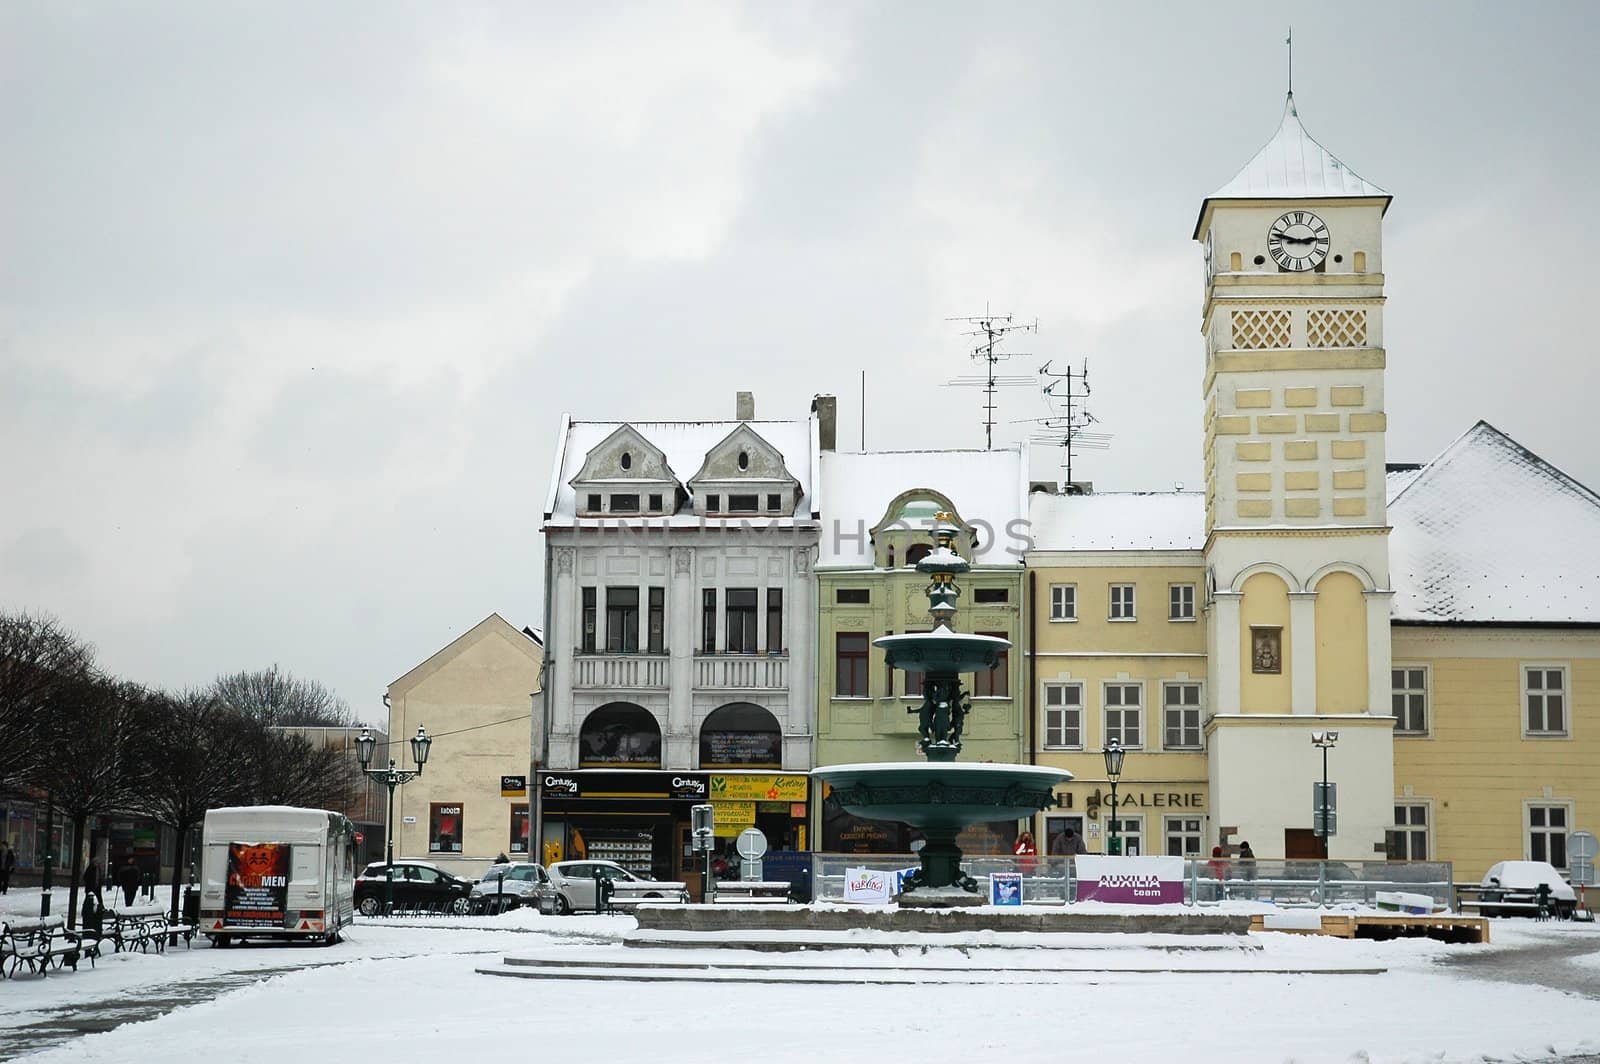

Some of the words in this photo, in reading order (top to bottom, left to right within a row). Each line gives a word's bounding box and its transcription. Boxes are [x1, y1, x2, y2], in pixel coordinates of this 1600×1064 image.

[545, 776, 572, 787] Century
[569, 782, 577, 792] 21
[672, 777, 700, 788] Century
[696, 783, 705, 793] 21
[1103, 793, 1204, 807] GALERIE
[1098, 875, 1160, 888] AUXILIA
